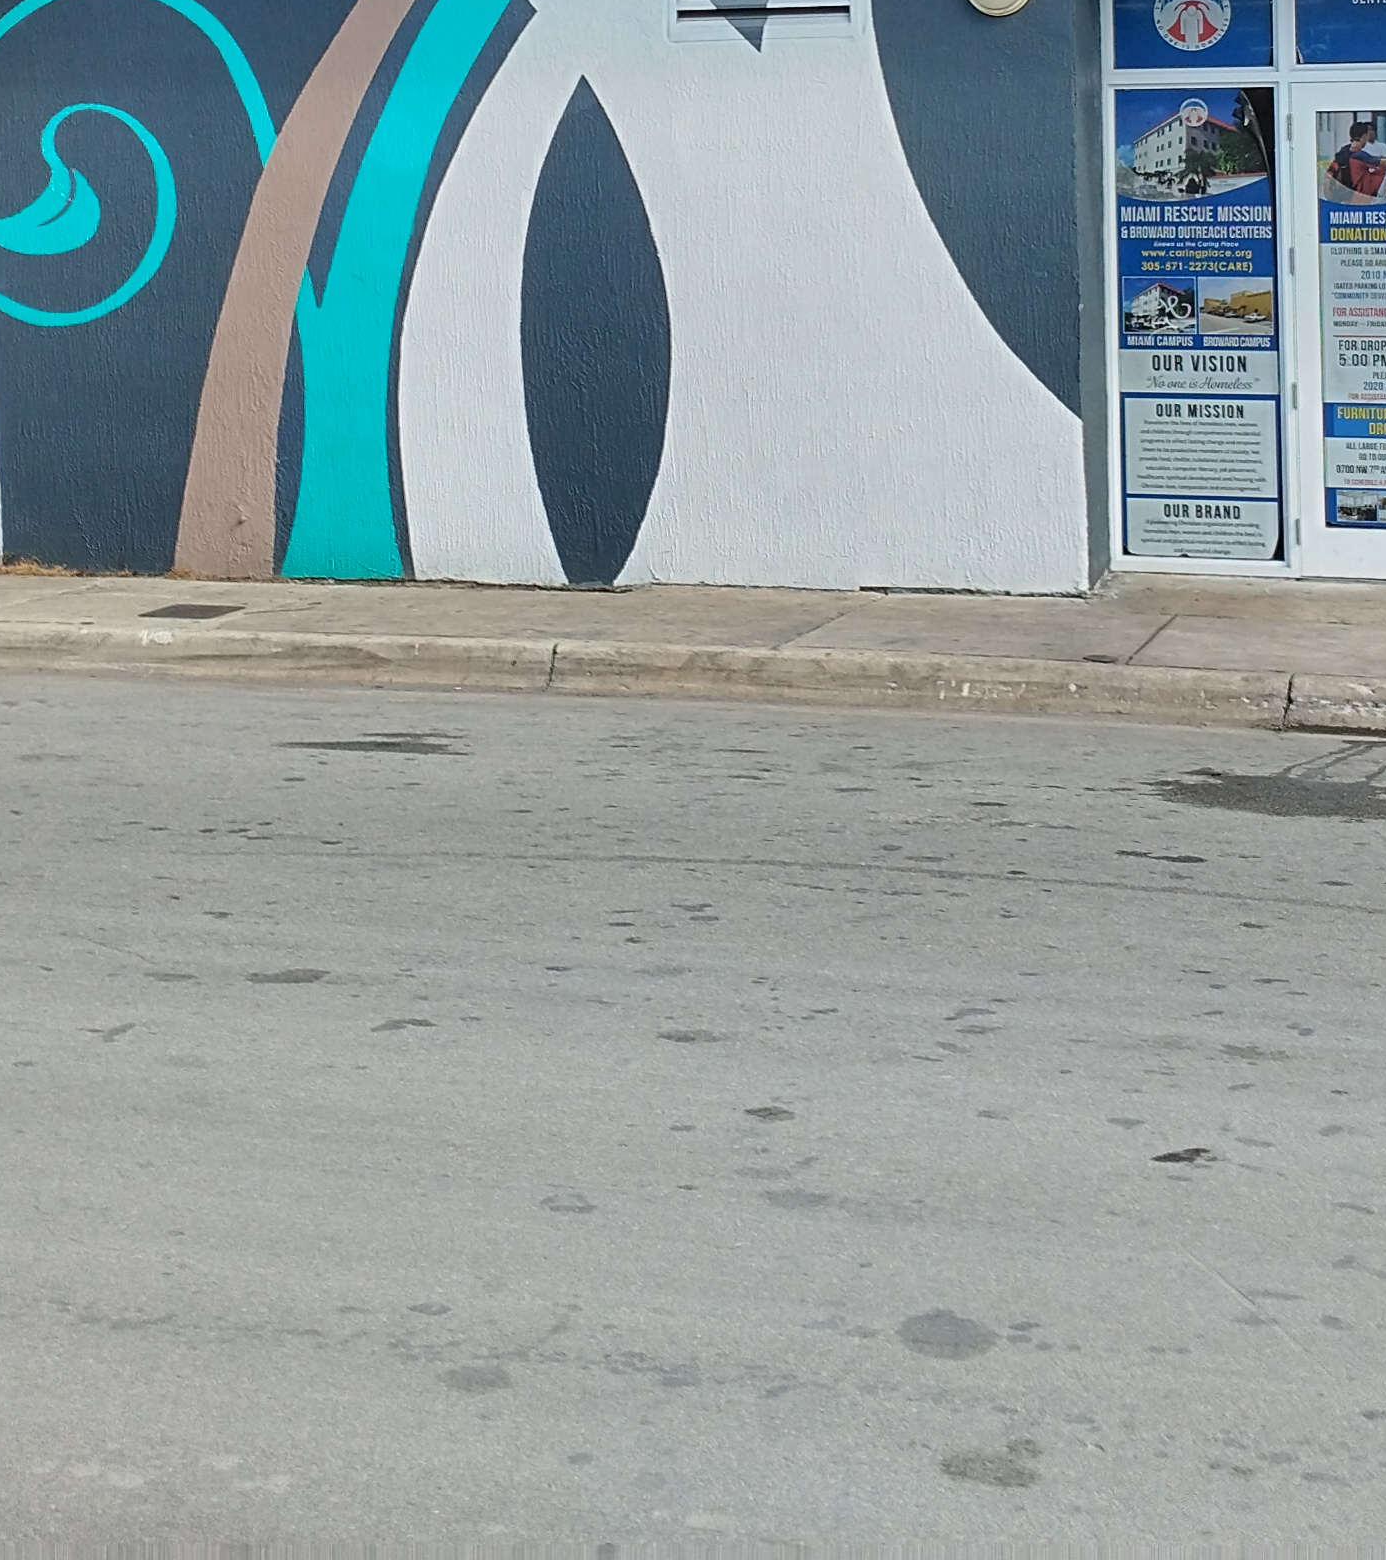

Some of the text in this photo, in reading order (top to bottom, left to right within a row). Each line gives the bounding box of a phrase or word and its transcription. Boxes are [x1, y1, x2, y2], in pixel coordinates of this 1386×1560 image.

[1121, 206, 1272, 222] MIAMI RESCUE MISSION
[1330, 211, 1362, 224] MIAMI
[1121, 226, 1272, 238] & BROWARD OUTREACH CENTERS
[1141, 249, 1252, 258] www.caringplace.org
[1340, 259, 1363, 267] PLEASE
[1361, 270, 1381, 279] 2010
[1333, 308, 1347, 317] FOR
[1127, 335, 1193, 346] MIAMI CAMPUS
[1203, 336, 1271, 347] BROWARD CAMPUS
[1338, 340, 1357, 351] FOR
[1152, 355, 1247, 372] OUR VISION
[1339, 354, 1368, 366] 5:00
[1363, 382, 1383, 390] 2020
[1156, 403, 1244, 418] OUR MISSION
[1356, 465, 1367, 474] NW
[1163, 503, 1241, 520] OUR BRAND
